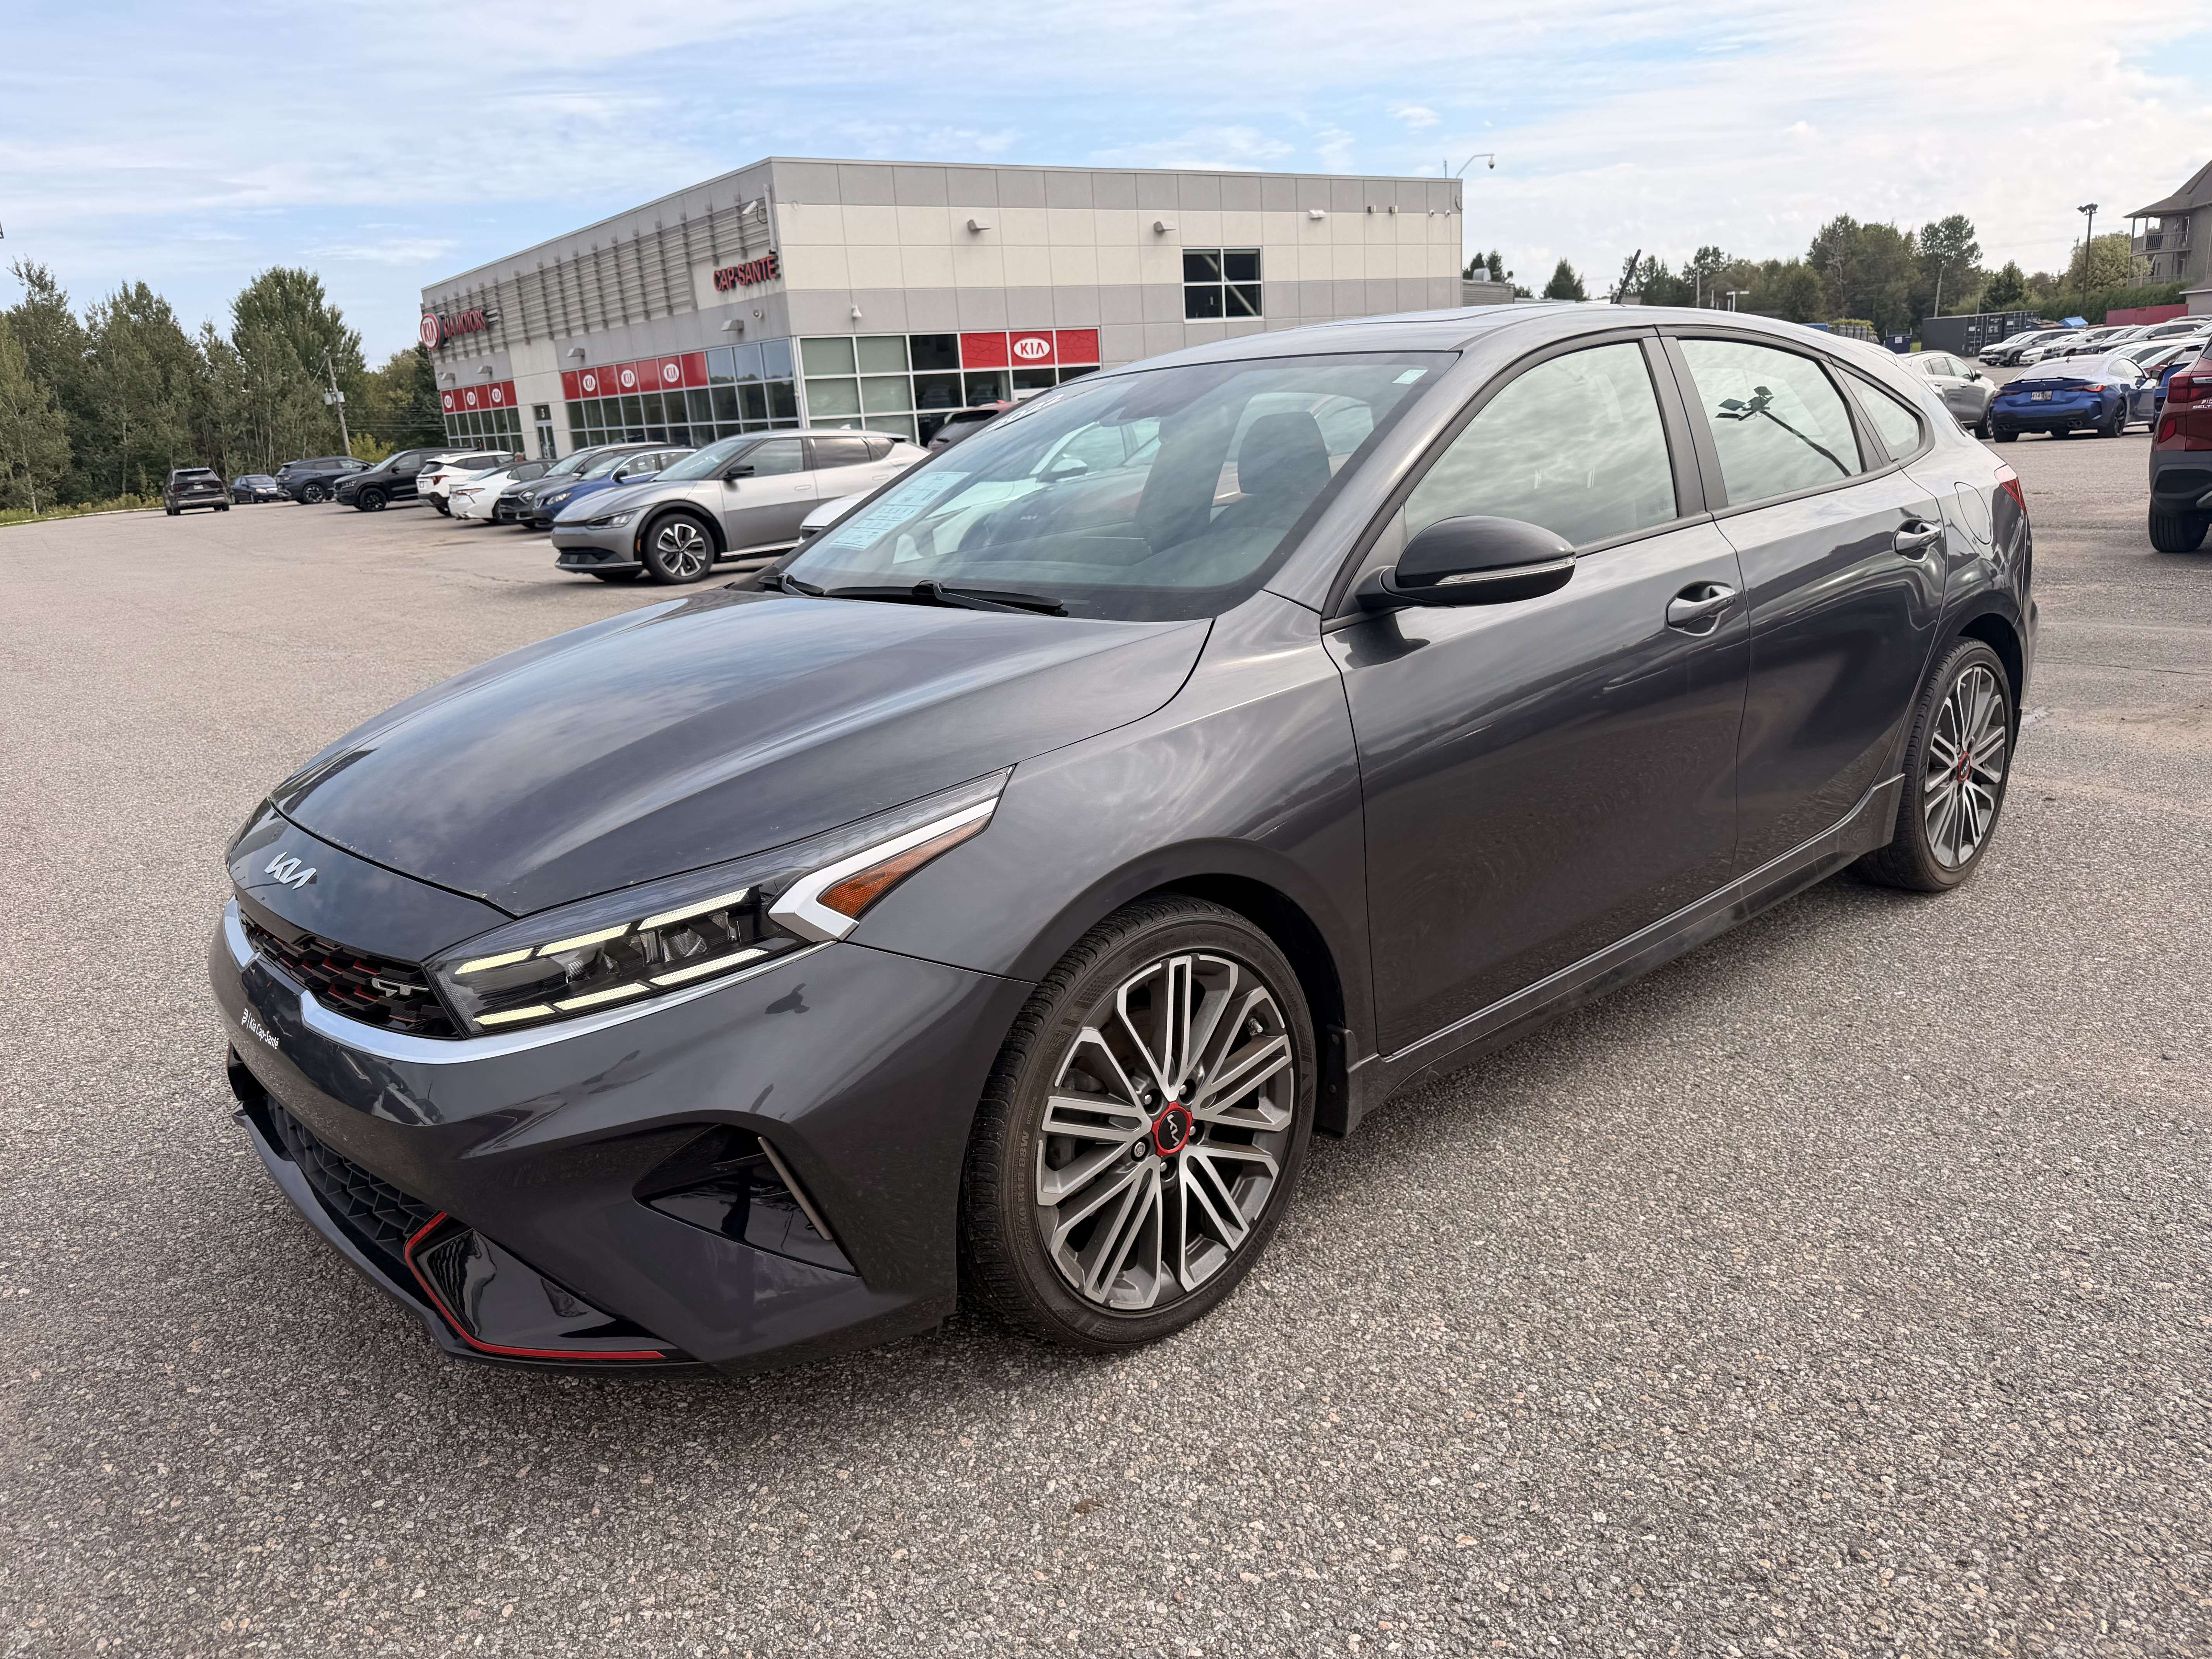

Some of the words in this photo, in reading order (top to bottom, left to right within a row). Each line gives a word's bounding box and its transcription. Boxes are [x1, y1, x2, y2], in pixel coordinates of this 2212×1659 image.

[422, 321, 437, 342] KIA
[443, 317, 456, 338] KIA
[455, 309, 486, 335] MOTORS
[1020, 342, 1045, 355] KIA
[666, 367, 678, 379] KIA
[264, 852, 317, 890] KIA
[371, 977, 429, 997] GT
[256, 1024, 279, 1049] Cap-Santé
[1018, 1130, 1029, 1167] 88W
